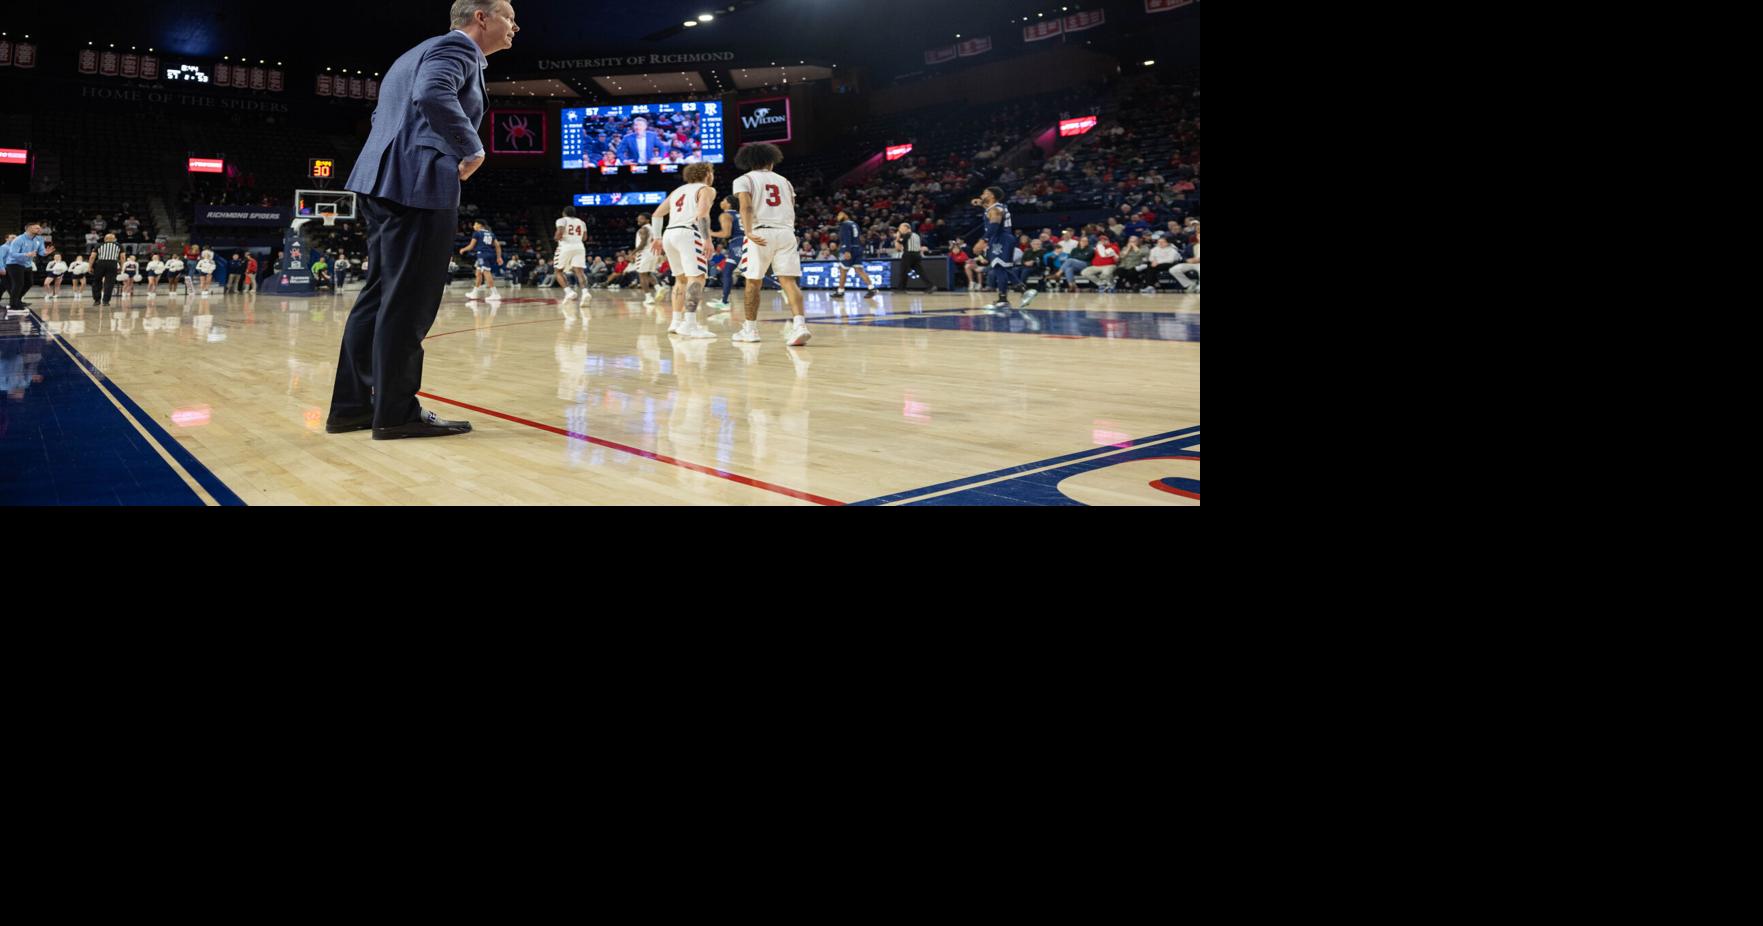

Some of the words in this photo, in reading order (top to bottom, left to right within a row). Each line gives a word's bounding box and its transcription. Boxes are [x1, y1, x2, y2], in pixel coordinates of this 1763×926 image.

[538, 58, 623, 71] UNIVERSITY
[627, 56, 646, 65] OF
[650, 51, 735, 65] RICHMOND
[81, 86, 143, 101] HOME
[148, 92, 173, 104] OF
[180, 94, 215, 107] THE
[221, 98, 288, 113] SPIDERS
[585, 107, 598, 116] 57
[682, 103, 697, 111] 53
[313, 166, 330, 177] 30
[765, 184, 781, 207] 3
[675, 194, 685, 212] 4
[206, 211, 248, 219] RICHMOND
[568, 224, 582, 236] 24
[807, 275, 819, 285] 57
